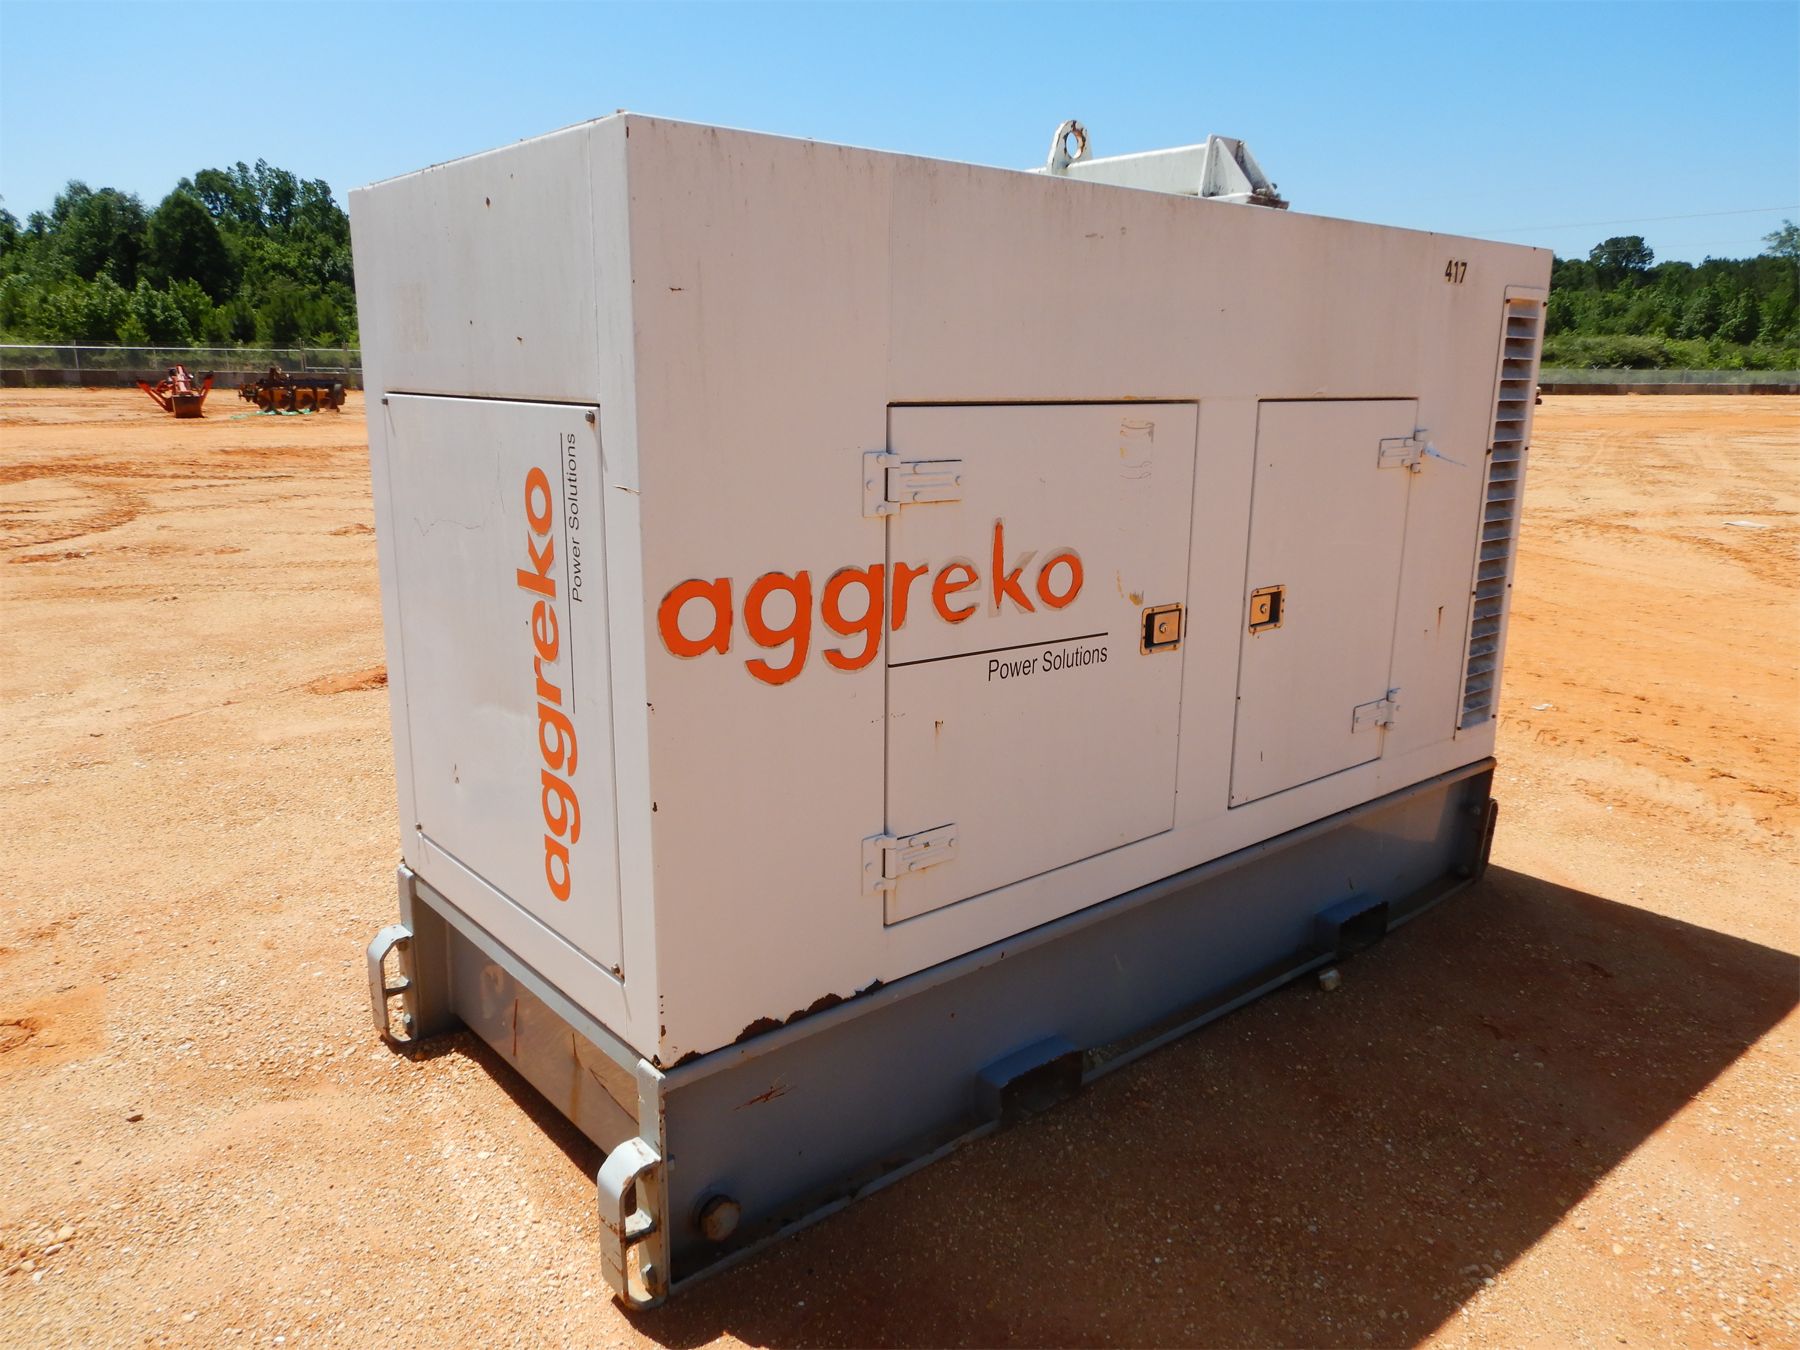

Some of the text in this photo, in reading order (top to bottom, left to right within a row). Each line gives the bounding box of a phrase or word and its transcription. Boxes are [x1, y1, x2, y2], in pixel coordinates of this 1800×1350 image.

[1444, 260, 1468, 284] 417
[566, 433, 583, 603] Power Solutions
[516, 466, 581, 902] aggreko
[657, 519, 1084, 685] aggreko
[987, 645, 1108, 682] Power Solutions
